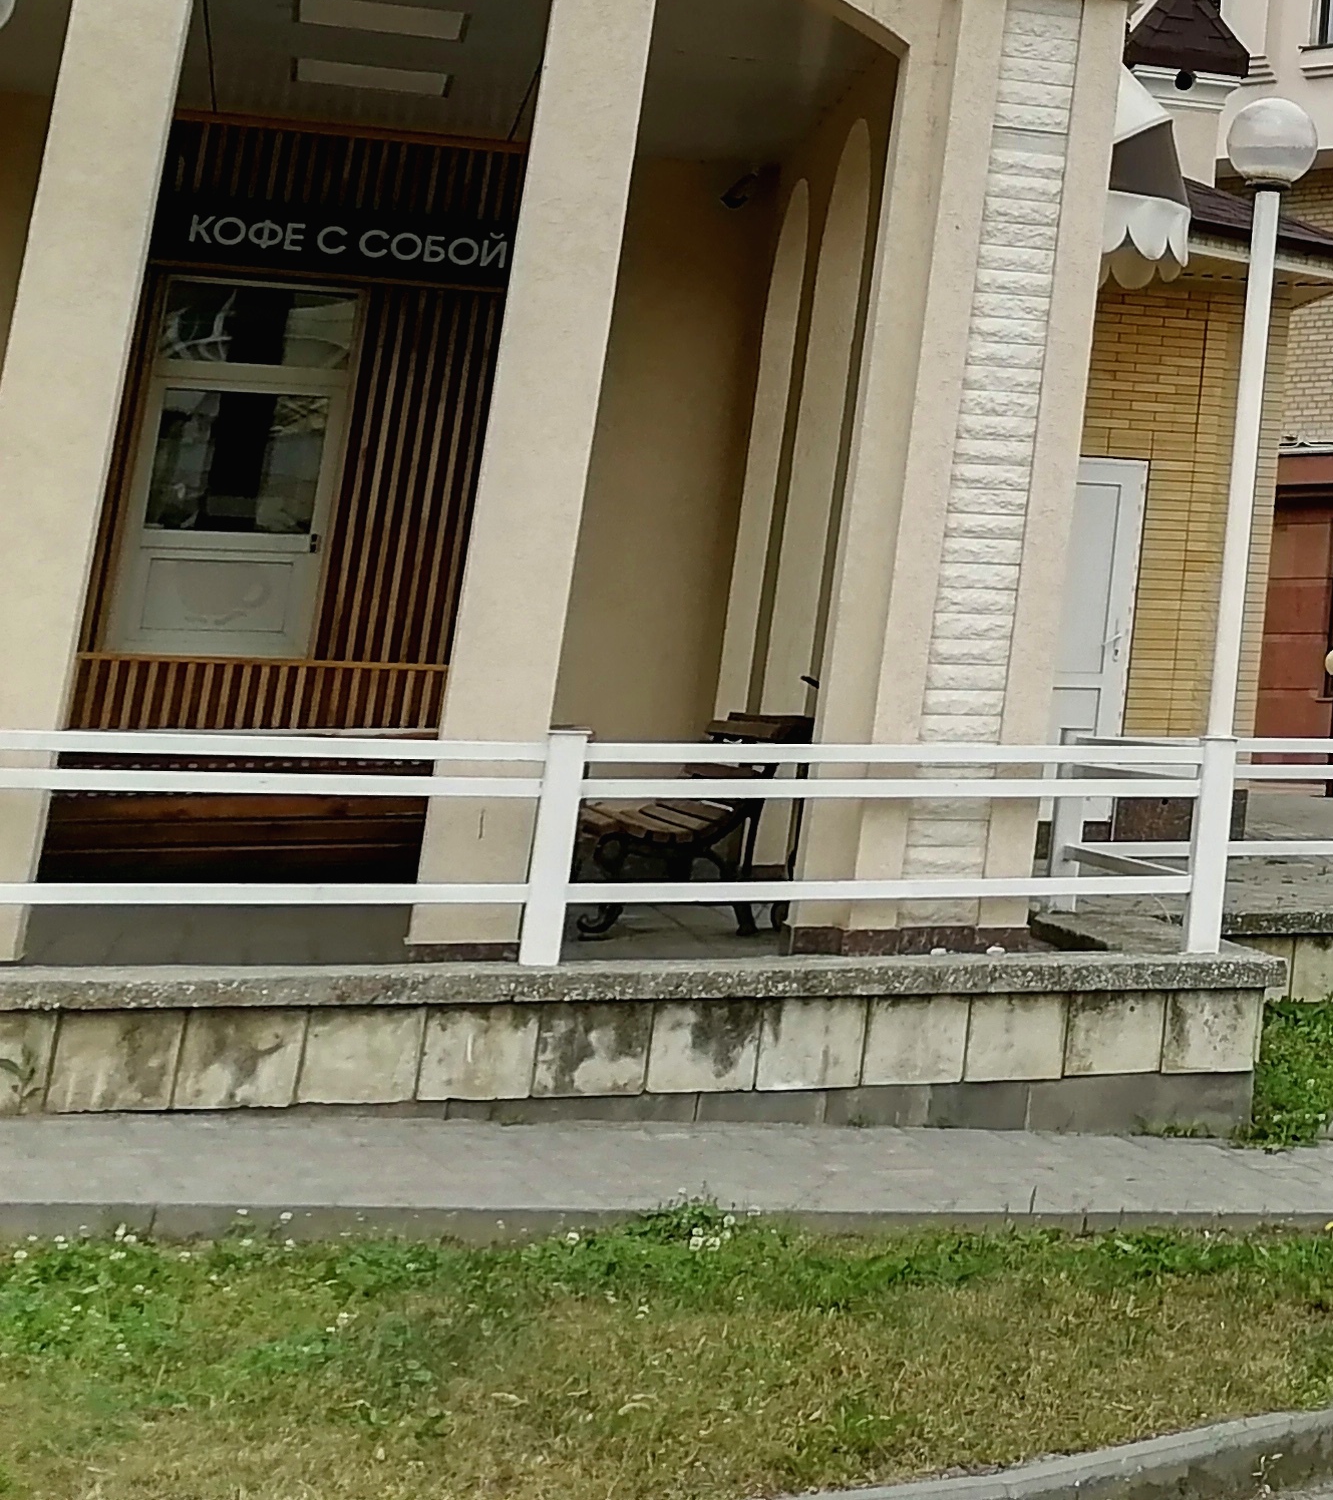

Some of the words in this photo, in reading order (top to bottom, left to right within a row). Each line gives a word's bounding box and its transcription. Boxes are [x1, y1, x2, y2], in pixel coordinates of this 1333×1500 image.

[188, 214, 306, 251] КОФЕ
[316, 226, 348, 254] С
[358, 229, 508, 269] СОБОЙ
